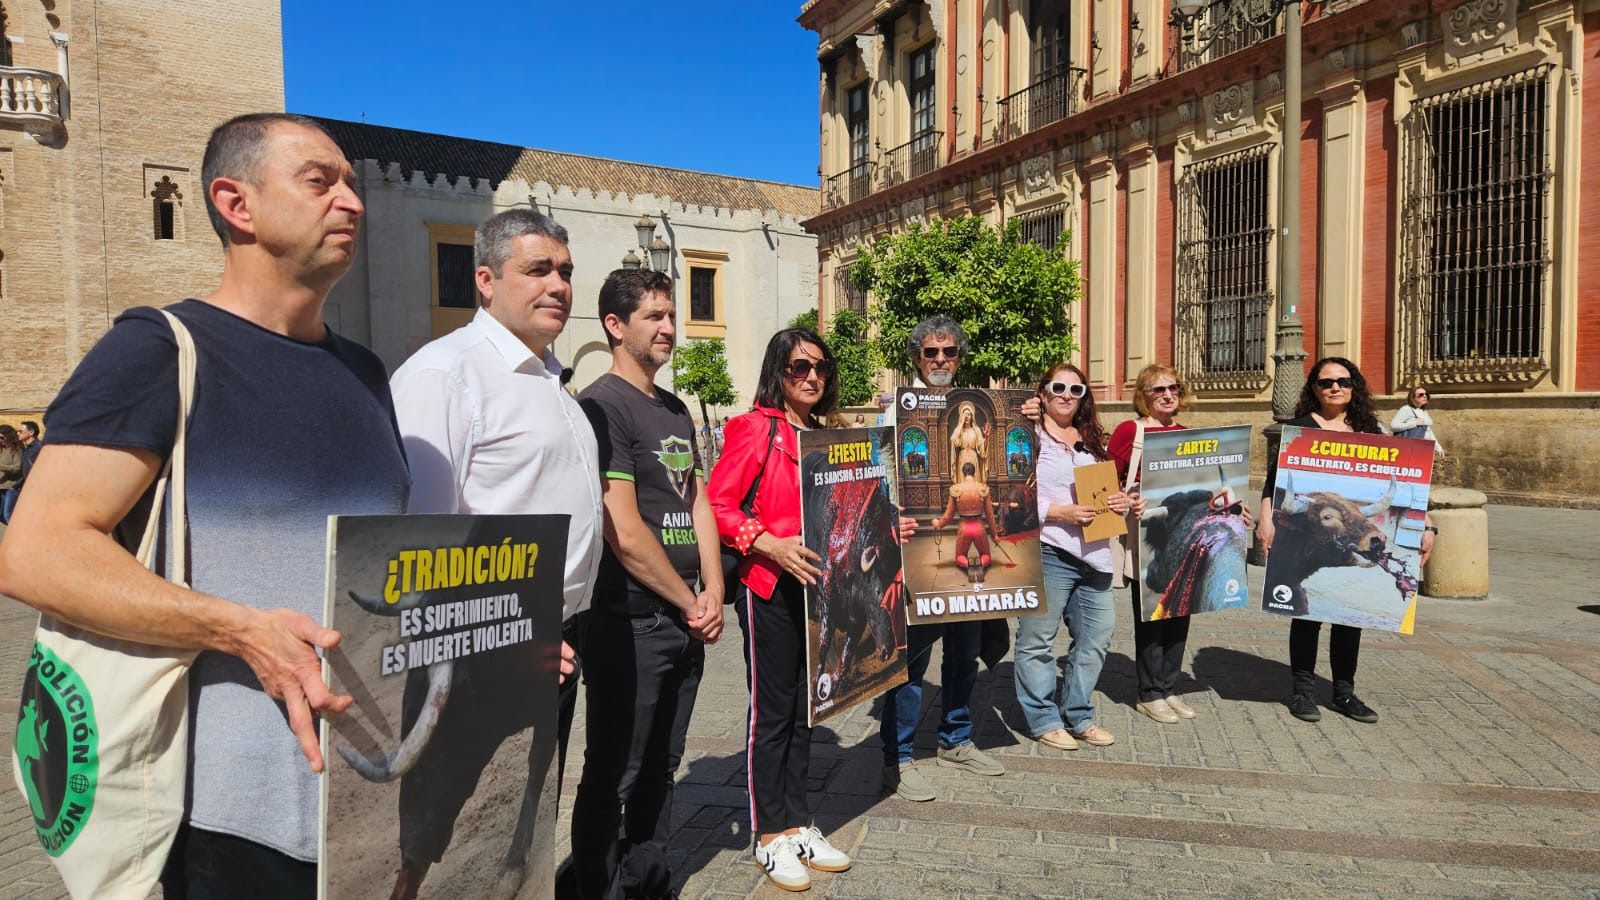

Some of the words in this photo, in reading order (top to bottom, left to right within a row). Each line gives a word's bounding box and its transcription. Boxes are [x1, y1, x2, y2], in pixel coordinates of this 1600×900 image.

[828, 441, 873, 465] ¿FIESTA?
[1176, 440, 1219, 456] ¿ARTE?
[1310, 440, 1400, 462] ¿CULTURA?
[1149, 462, 1159, 471] ES
[1160, 459, 1194, 470] TORTURA,
[1195, 457, 1205, 467] ES
[1205, 454, 1243, 465] ASESINATO
[1287, 456, 1300, 466] ES
[1301, 457, 1354, 471] MALTRATO,
[1355, 462, 1369, 473] ES
[1369, 464, 1423, 478] CRUELDAD
[814, 473, 824, 487] ES
[824, 468, 855, 485] SADISMO,
[855, 467, 864, 481] ES
[384, 537, 539, 604] ¿TRADICIÓN?
[916, 597, 946, 617] NO
[948, 588, 1039, 614] MATARÁS
[400, 608, 423, 637] ES
[424, 593, 523, 633] SUFRIMIENTO,
[382, 644, 406, 676] ES
[408, 631, 471, 669] MUERTE
[472, 618, 533, 653] VIOLENTA
